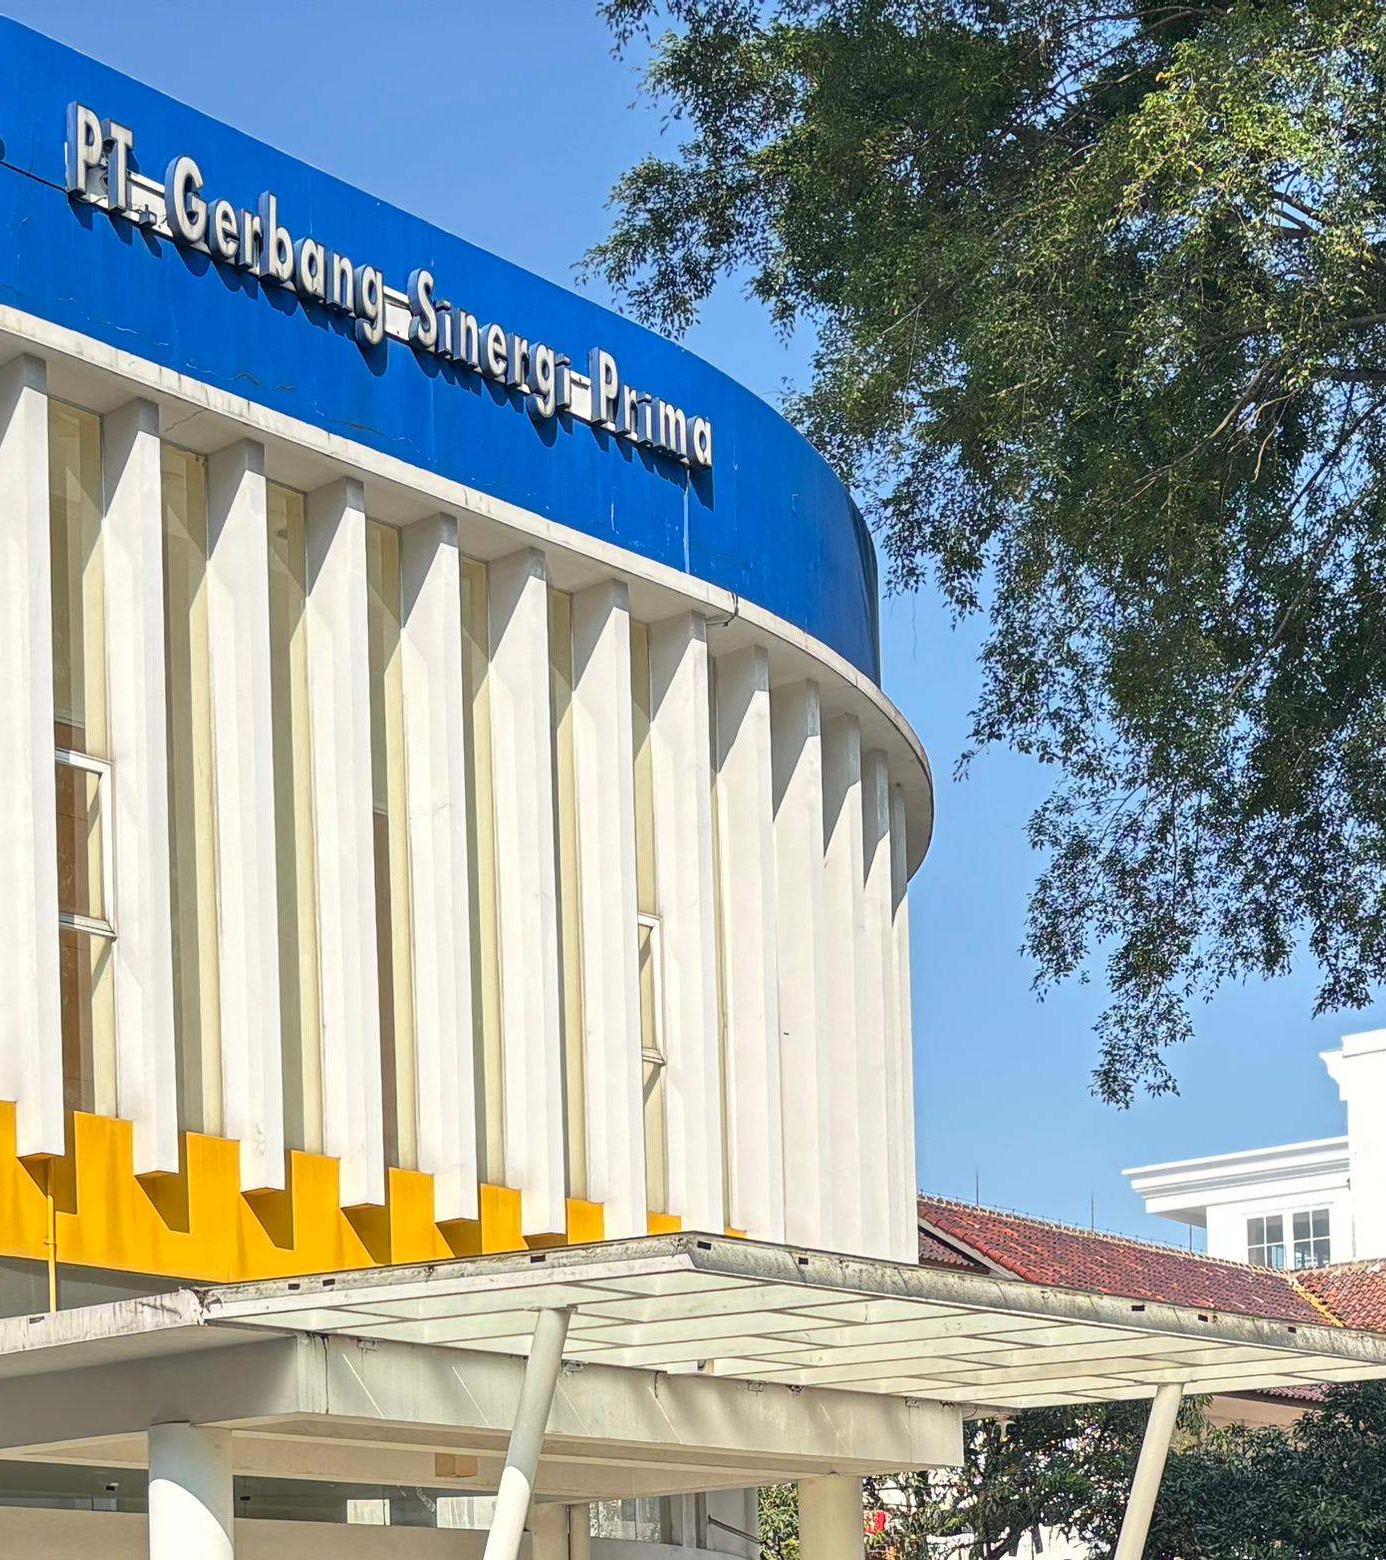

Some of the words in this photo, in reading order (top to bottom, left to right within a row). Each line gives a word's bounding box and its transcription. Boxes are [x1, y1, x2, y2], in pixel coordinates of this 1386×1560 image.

[164, 154, 384, 345] Gerbang
[407, 267, 571, 418] Sinergi
[589, 347, 713, 468] Prima
